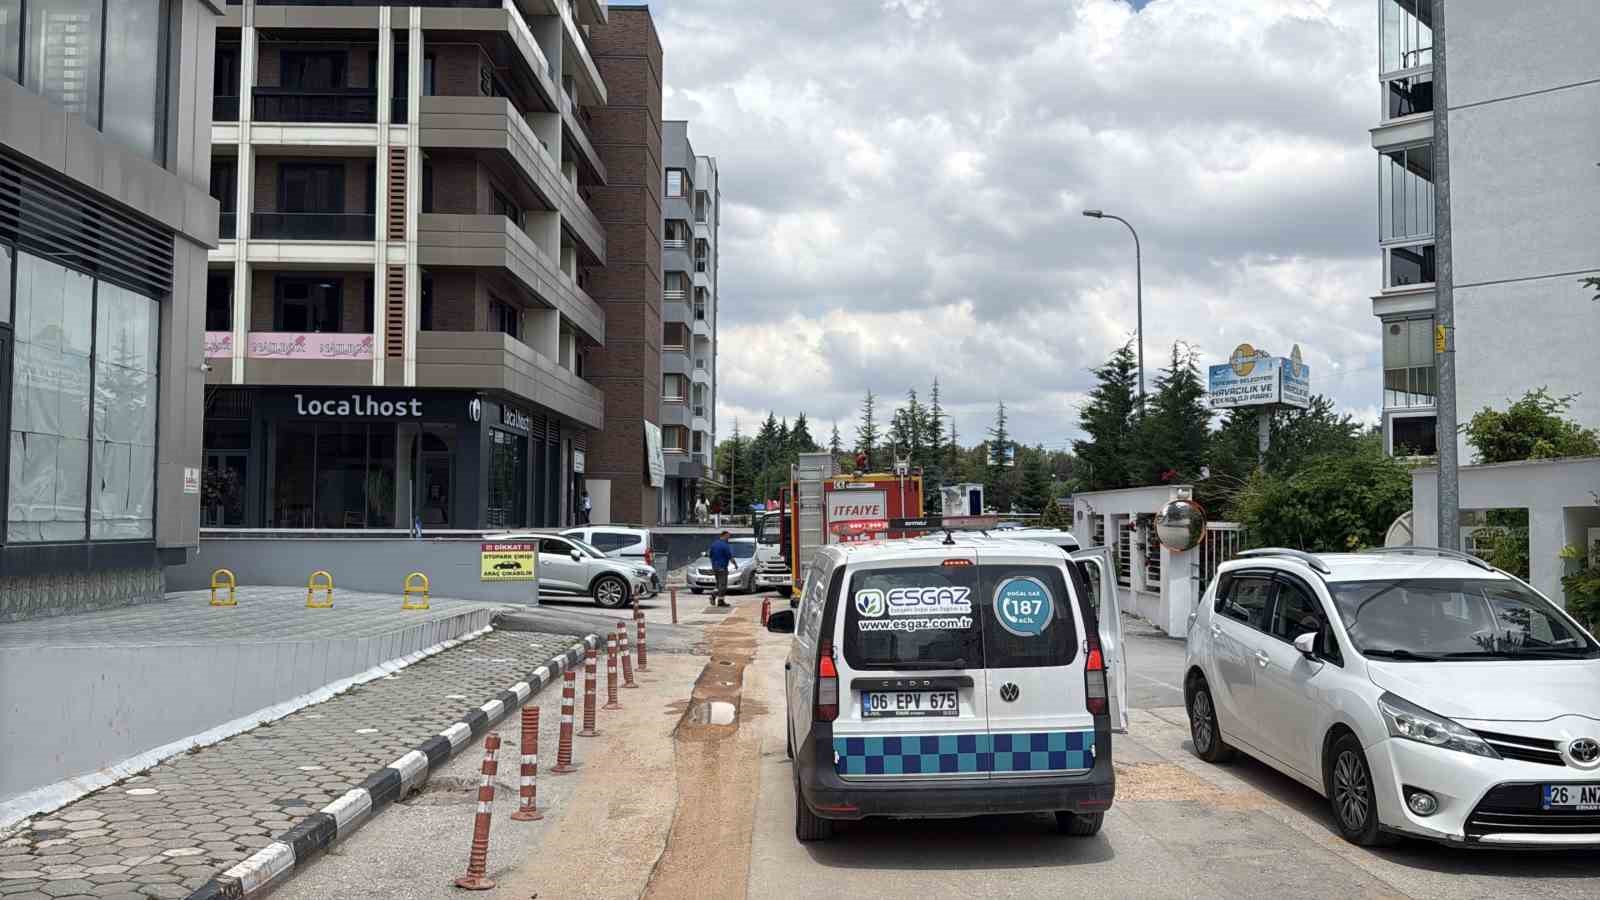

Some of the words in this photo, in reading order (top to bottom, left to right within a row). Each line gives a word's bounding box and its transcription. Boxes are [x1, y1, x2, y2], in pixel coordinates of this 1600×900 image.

[1261, 384, 1273, 392] VE
[294, 394, 423, 417] localhost
[889, 588, 970, 607] ESGAZ
[1011, 600, 1042, 615] 187
[859, 617, 973, 631] www.esgaz.com.tr
[871, 694, 888, 710] 06
[896, 693, 921, 710] EPV
[930, 693, 956, 709] 675
[1552, 787, 1568, 803] 26
